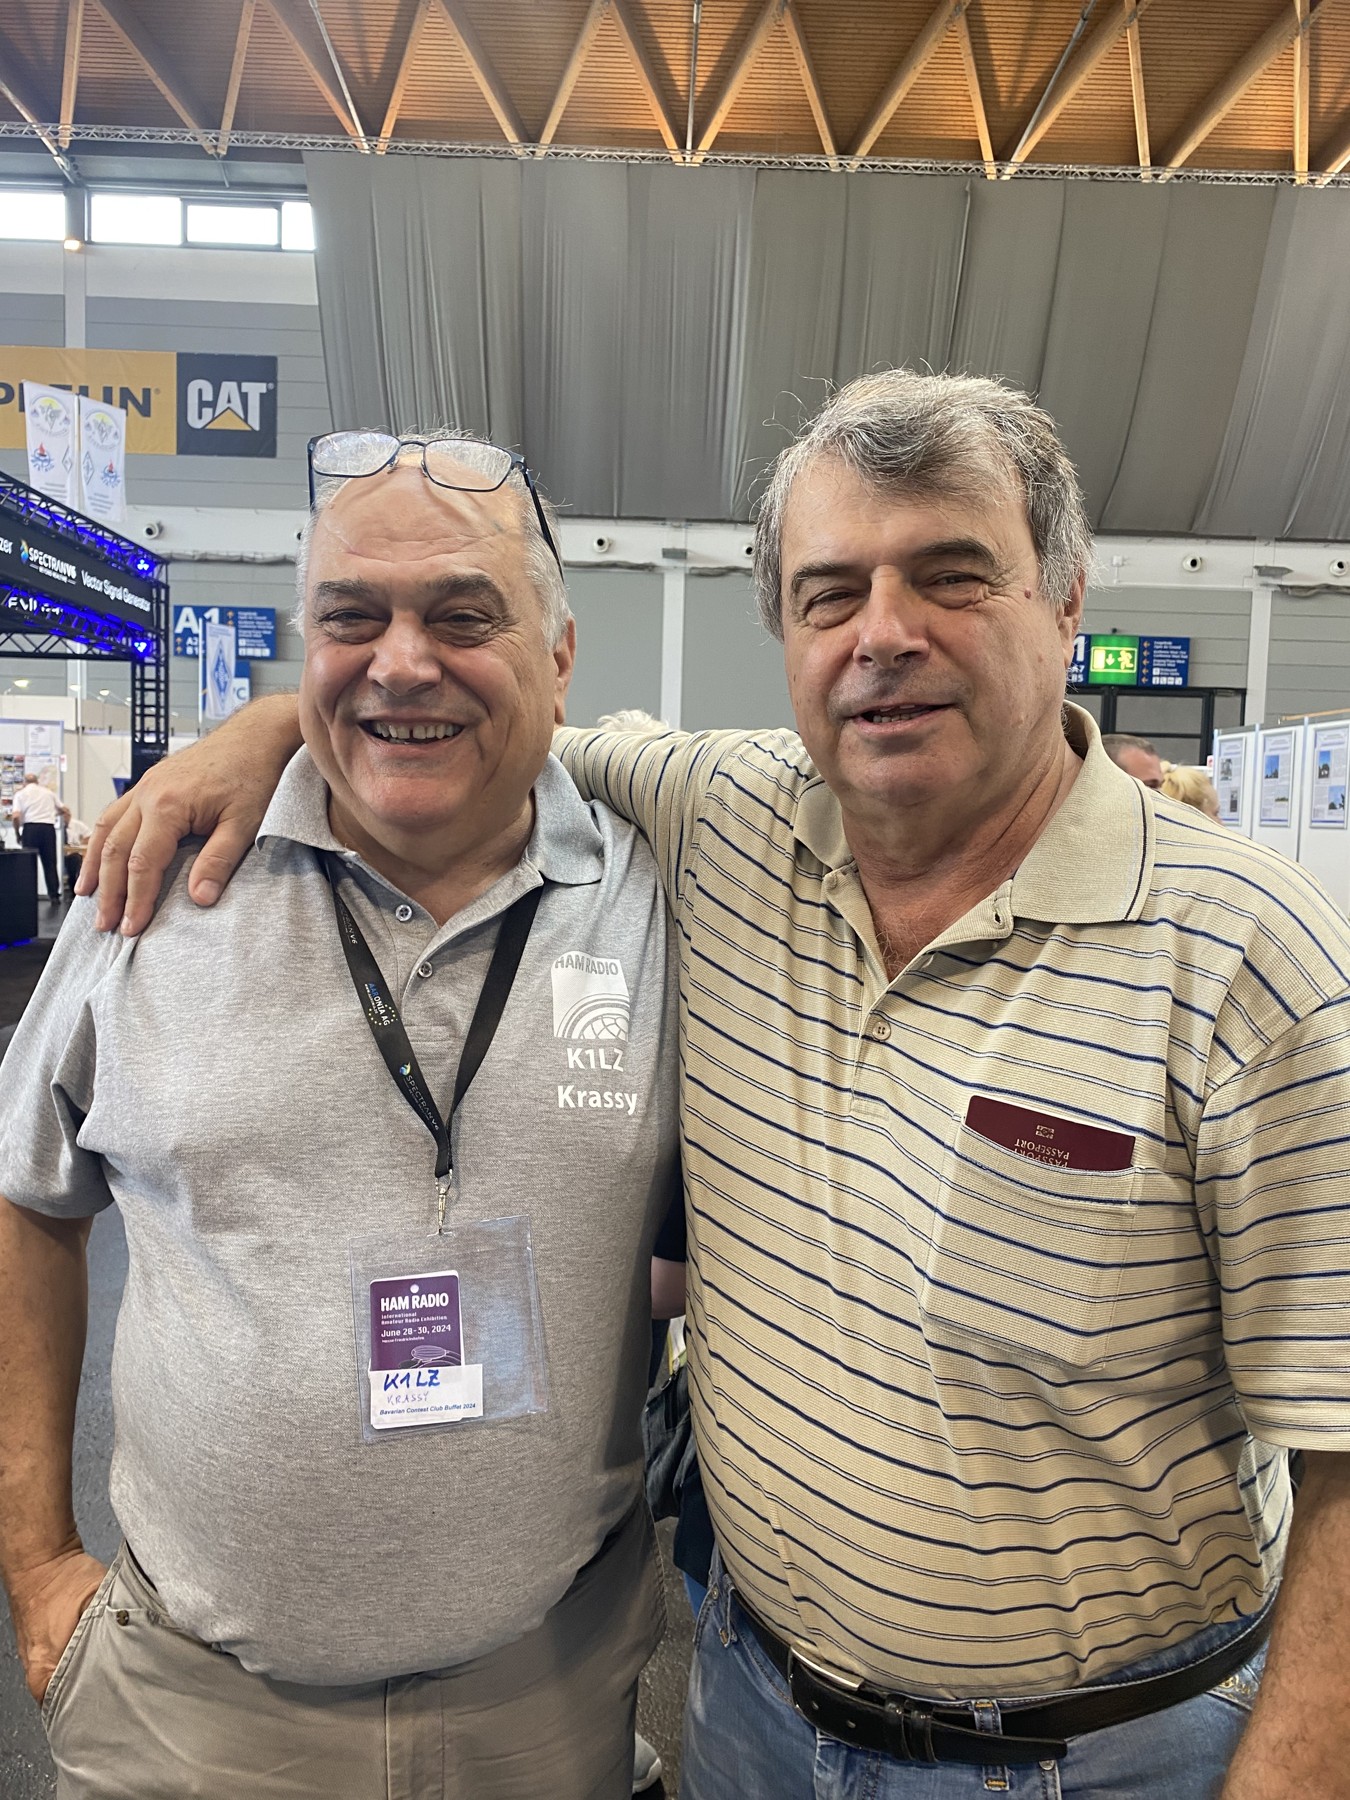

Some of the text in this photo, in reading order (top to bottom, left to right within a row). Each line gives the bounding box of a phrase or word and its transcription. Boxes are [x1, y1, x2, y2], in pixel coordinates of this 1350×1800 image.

[187, 379, 267, 431] CAT
[174, 607, 220, 634] A1
[586, 958, 619, 976] RADIO
[367, 983, 391, 1027] AARONIA AG
[566, 1047, 625, 1073] K1LZ
[558, 1085, 638, 1116] Krassy
[1014, 1137, 1070, 1160] PASSEPORT
[380, 1292, 450, 1312] HAM RADIO
[381, 1329, 401, 1338] June
[432, 1324, 451, 1333] 2024
[383, 1369, 441, 1392] K1LZ
[379, 1408, 406, 1416] Bavarian
[406, 1406, 429, 1414] Contest
[430, 1405, 443, 1413] Club
[444, 1404, 462, 1412] Buffet
